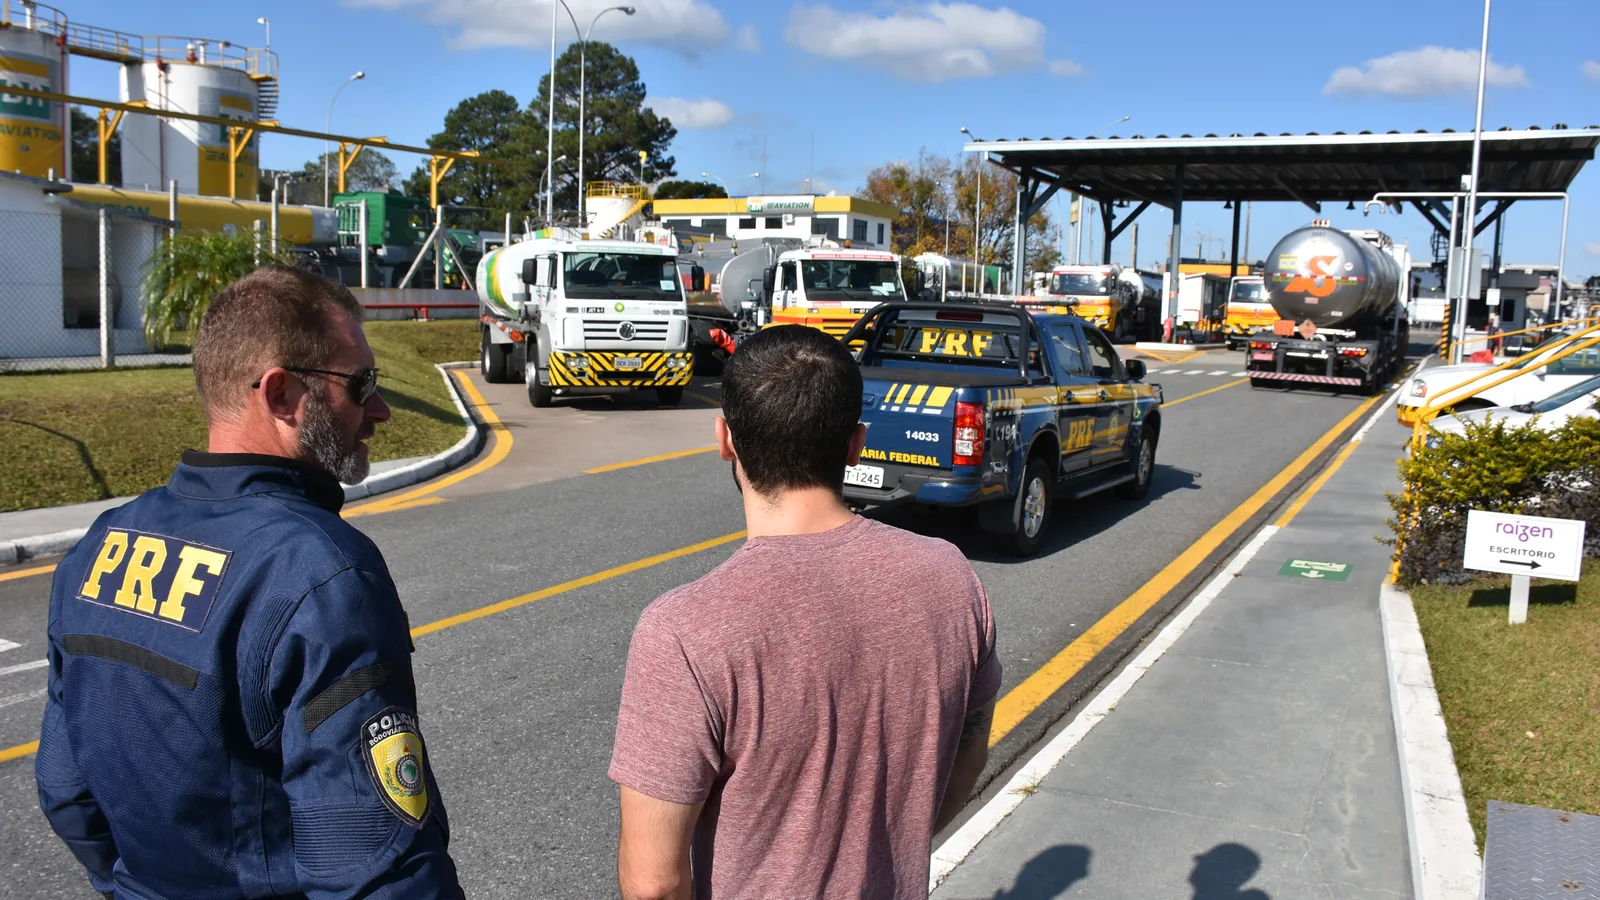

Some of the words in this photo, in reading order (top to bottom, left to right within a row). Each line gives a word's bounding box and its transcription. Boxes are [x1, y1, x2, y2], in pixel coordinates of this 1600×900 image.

[920, 327, 993, 357] PRF
[905, 430, 939, 442] 14033
[1068, 417, 1096, 450] PRF
[889, 451, 940, 466] FEDERAL
[1496, 521, 1553, 542] raízen
[1489, 545, 1555, 559] ESCRITÓRIO
[81, 531, 227, 622] PRF
